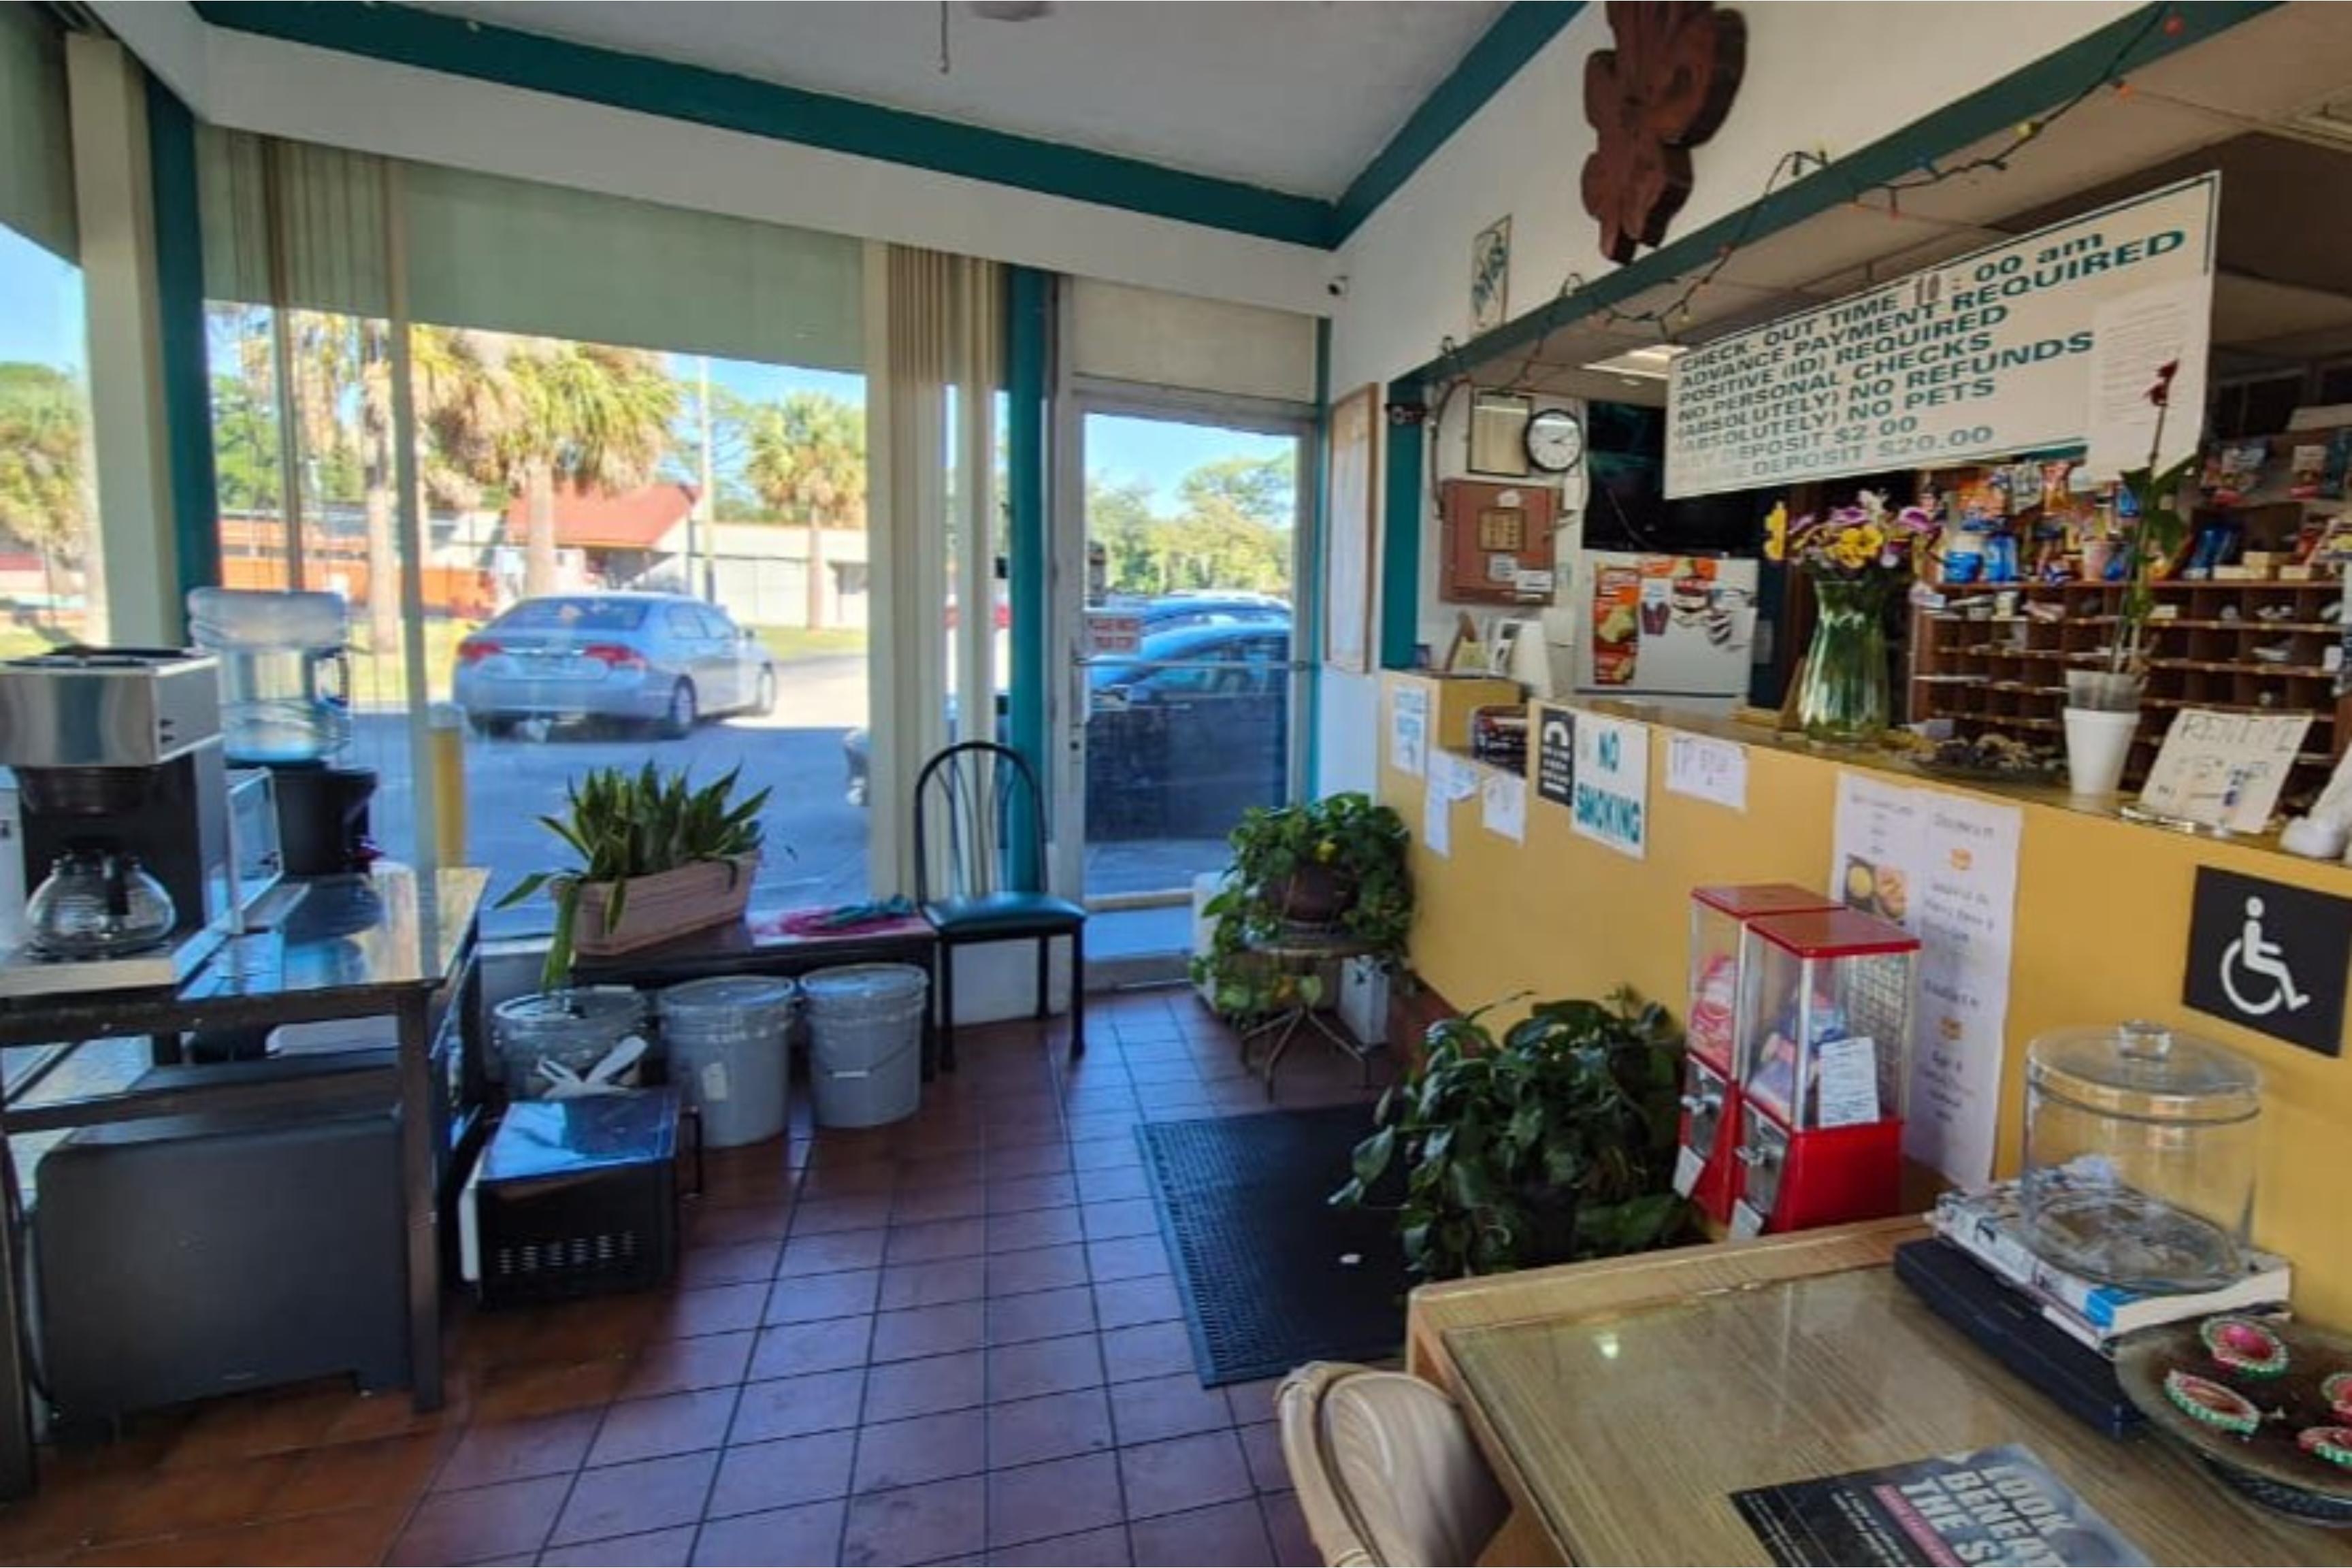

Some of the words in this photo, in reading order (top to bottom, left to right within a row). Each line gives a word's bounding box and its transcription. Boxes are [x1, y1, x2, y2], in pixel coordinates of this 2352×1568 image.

[1680, 348, 1786, 387] ADVANCE
[1792, 303, 1934, 357] PAYMENT
[1951, 230, 2186, 312] REQUIRED
[1763, 319, 1817, 346] OUT
[1827, 292, 1898, 327] TIME
[1975, 255, 2022, 283] 00
[2036, 233, 2102, 263] am
[1678, 406, 1708, 423] NO
[1713, 372, 1842, 414] PERSONAL
[1852, 332, 1992, 380] CHECKS
[1679, 369, 1774, 405] POSITIVE
[1835, 306, 2008, 365] REQUIRED
[1848, 379, 1893, 402] NO
[1906, 332, 2093, 389] REFUNDS
[1847, 400, 1892, 422] NO
[1904, 378, 1994, 410] PETS
[1752, 446, 1863, 476] DEPOSIT
[1876, 426, 1993, 457] $20.00
[1599, 730, 1620, 773] NO
[1577, 783, 1641, 845] SMOKING
[1901, 1478, 1976, 1533] THE
[1979, 1467, 2076, 1536] LOOK
